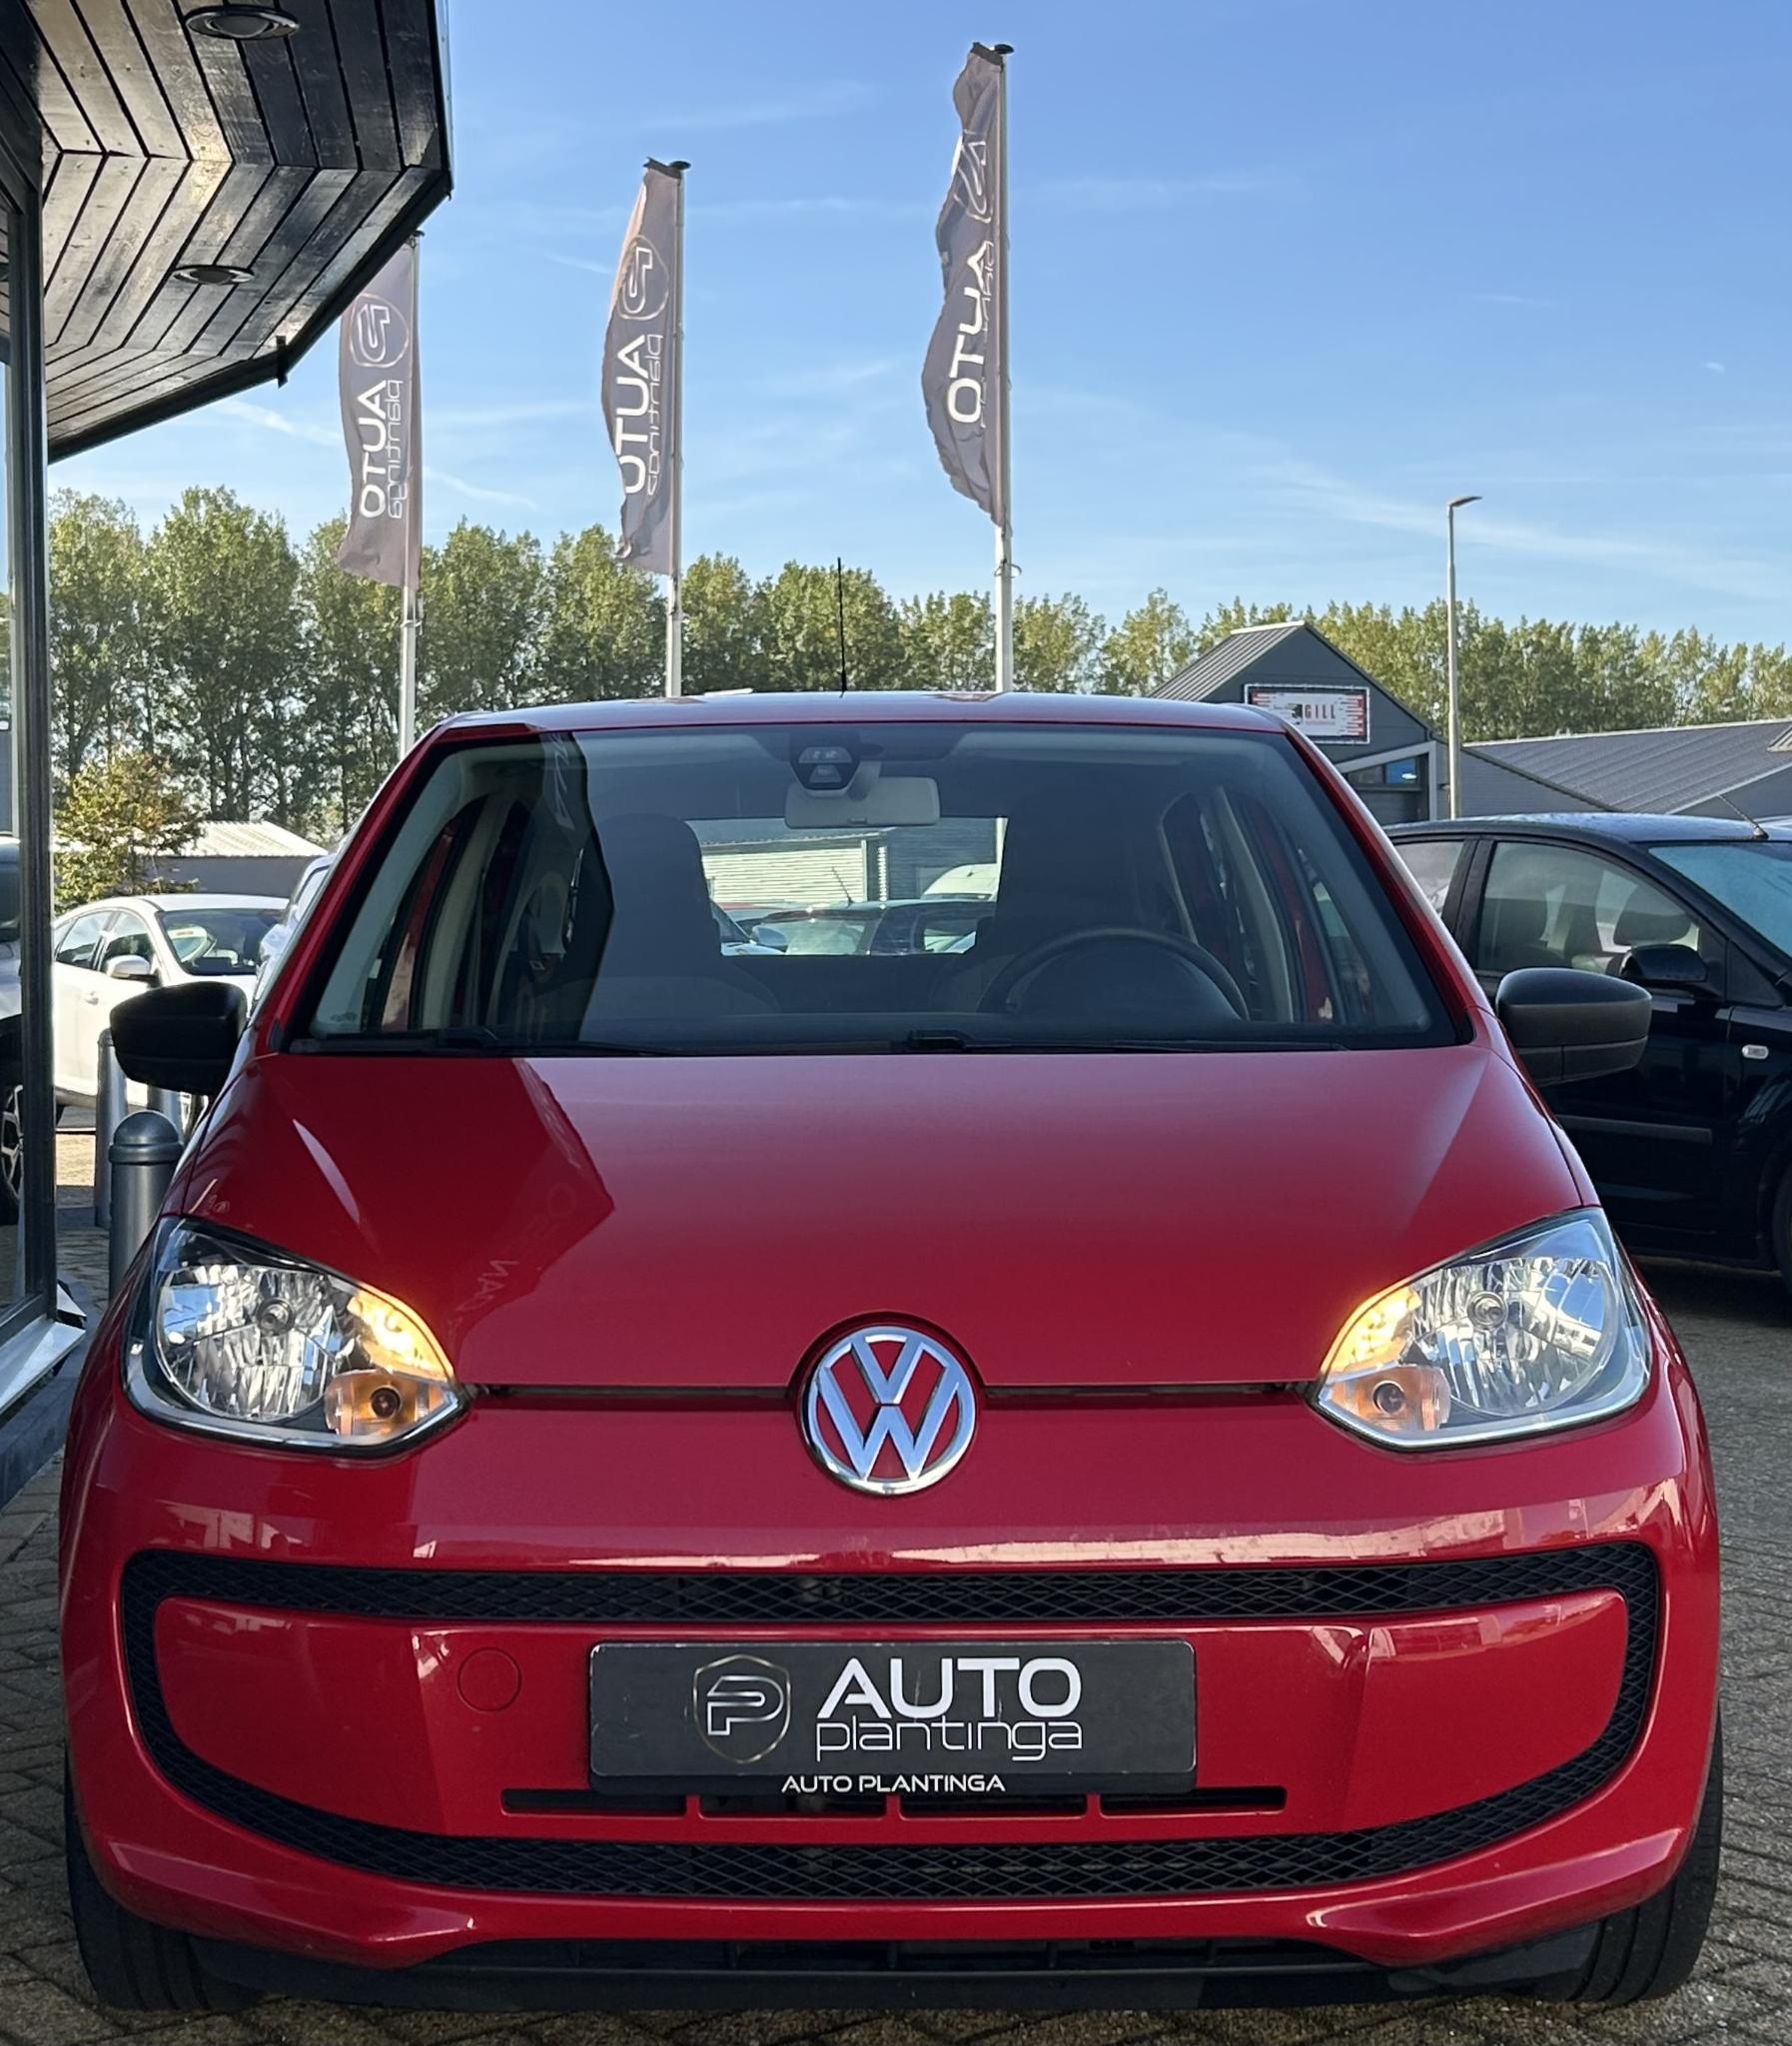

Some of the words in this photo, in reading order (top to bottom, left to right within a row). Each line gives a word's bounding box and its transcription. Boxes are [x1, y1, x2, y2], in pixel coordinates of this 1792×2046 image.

[1304, 703, 1337, 719] GILL
[816, 1657, 1082, 1719] AUTO
[816, 1714, 1083, 1763] plantinga
[781, 1774, 851, 1793] AUTO
[858, 1774, 1007, 1793] PLANTINGA
